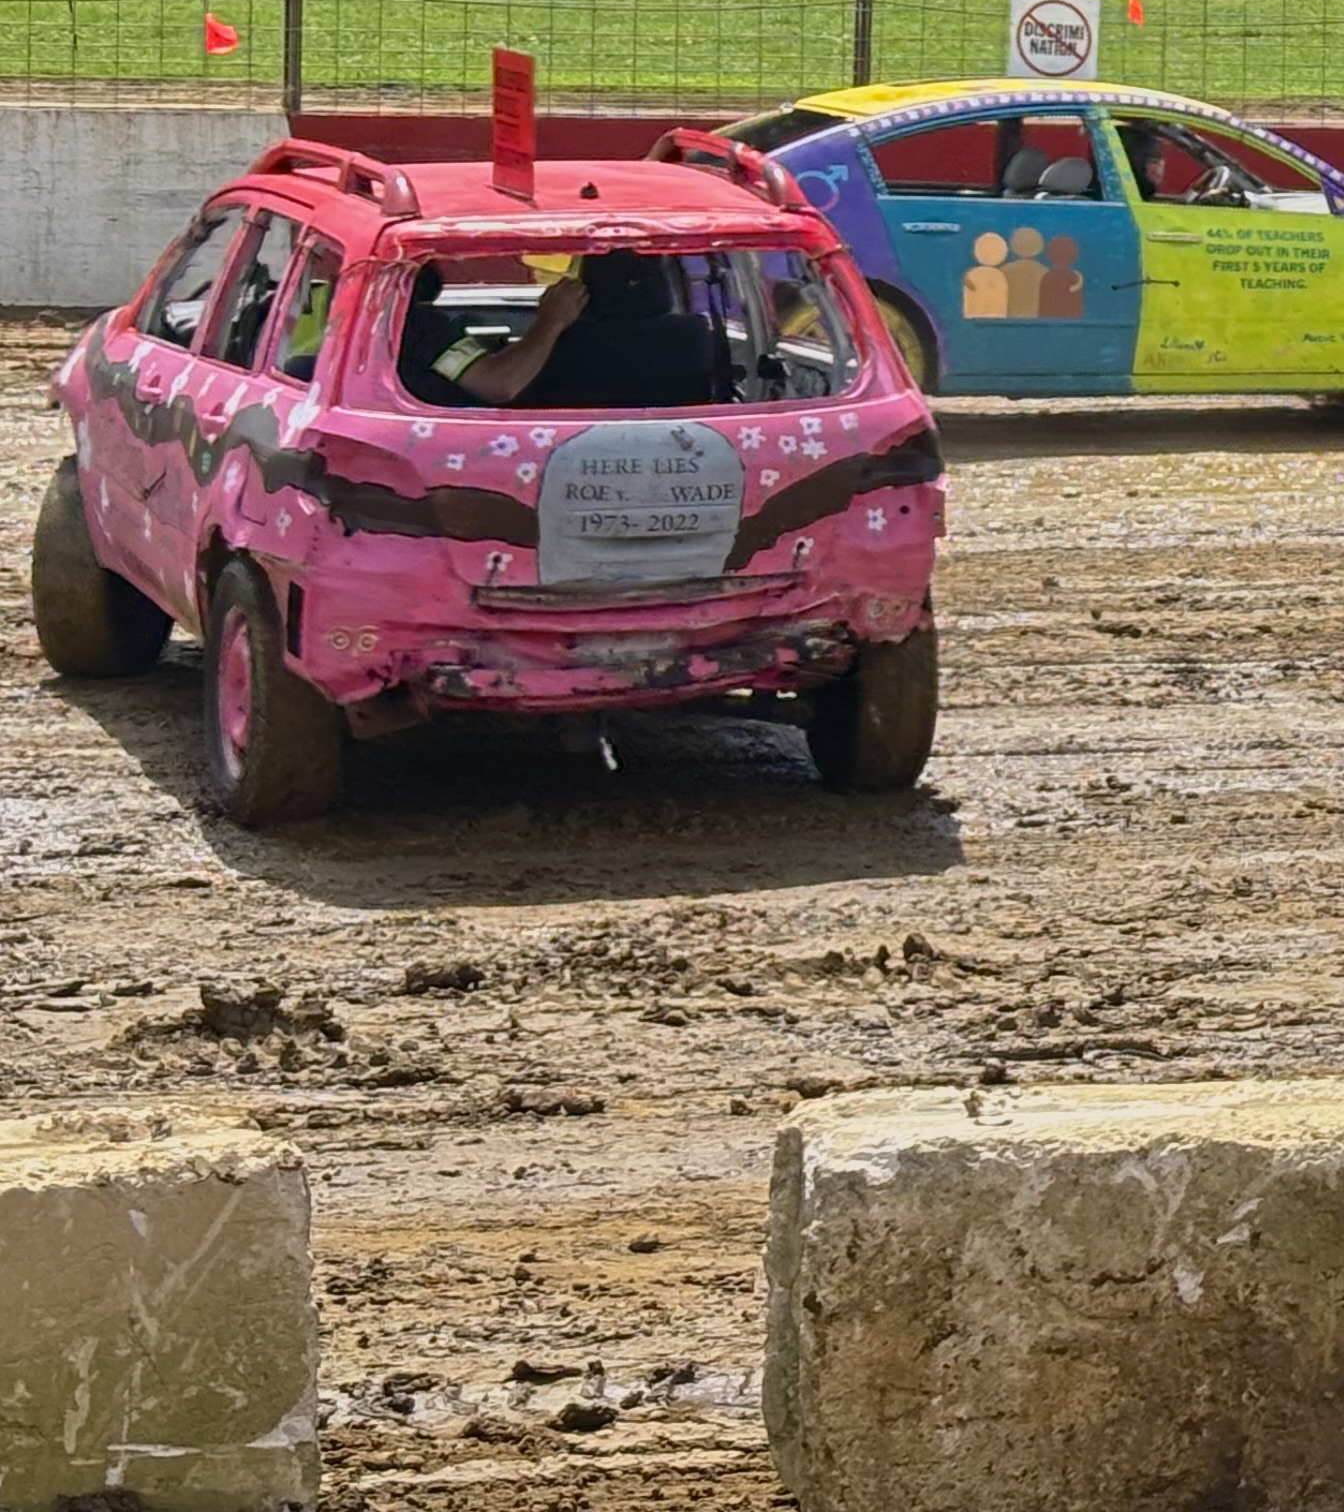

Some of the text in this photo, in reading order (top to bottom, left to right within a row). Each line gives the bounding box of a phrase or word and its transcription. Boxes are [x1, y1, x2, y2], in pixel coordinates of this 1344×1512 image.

[1236, 228, 1253, 240] OF
[1256, 230, 1325, 243] TEACHERS
[1206, 244, 1330, 260] DROP OUT IN THEIR
[1212, 260, 1249, 272] FIRST
[1264, 262, 1306, 274] YEARS
[1308, 262, 1327, 274] OF
[581, 457, 701, 476] HERE LIES
[564, 483, 611, 502] ROE
[670, 483, 737, 503] WADE
[647, 513, 700, 532] 2022
